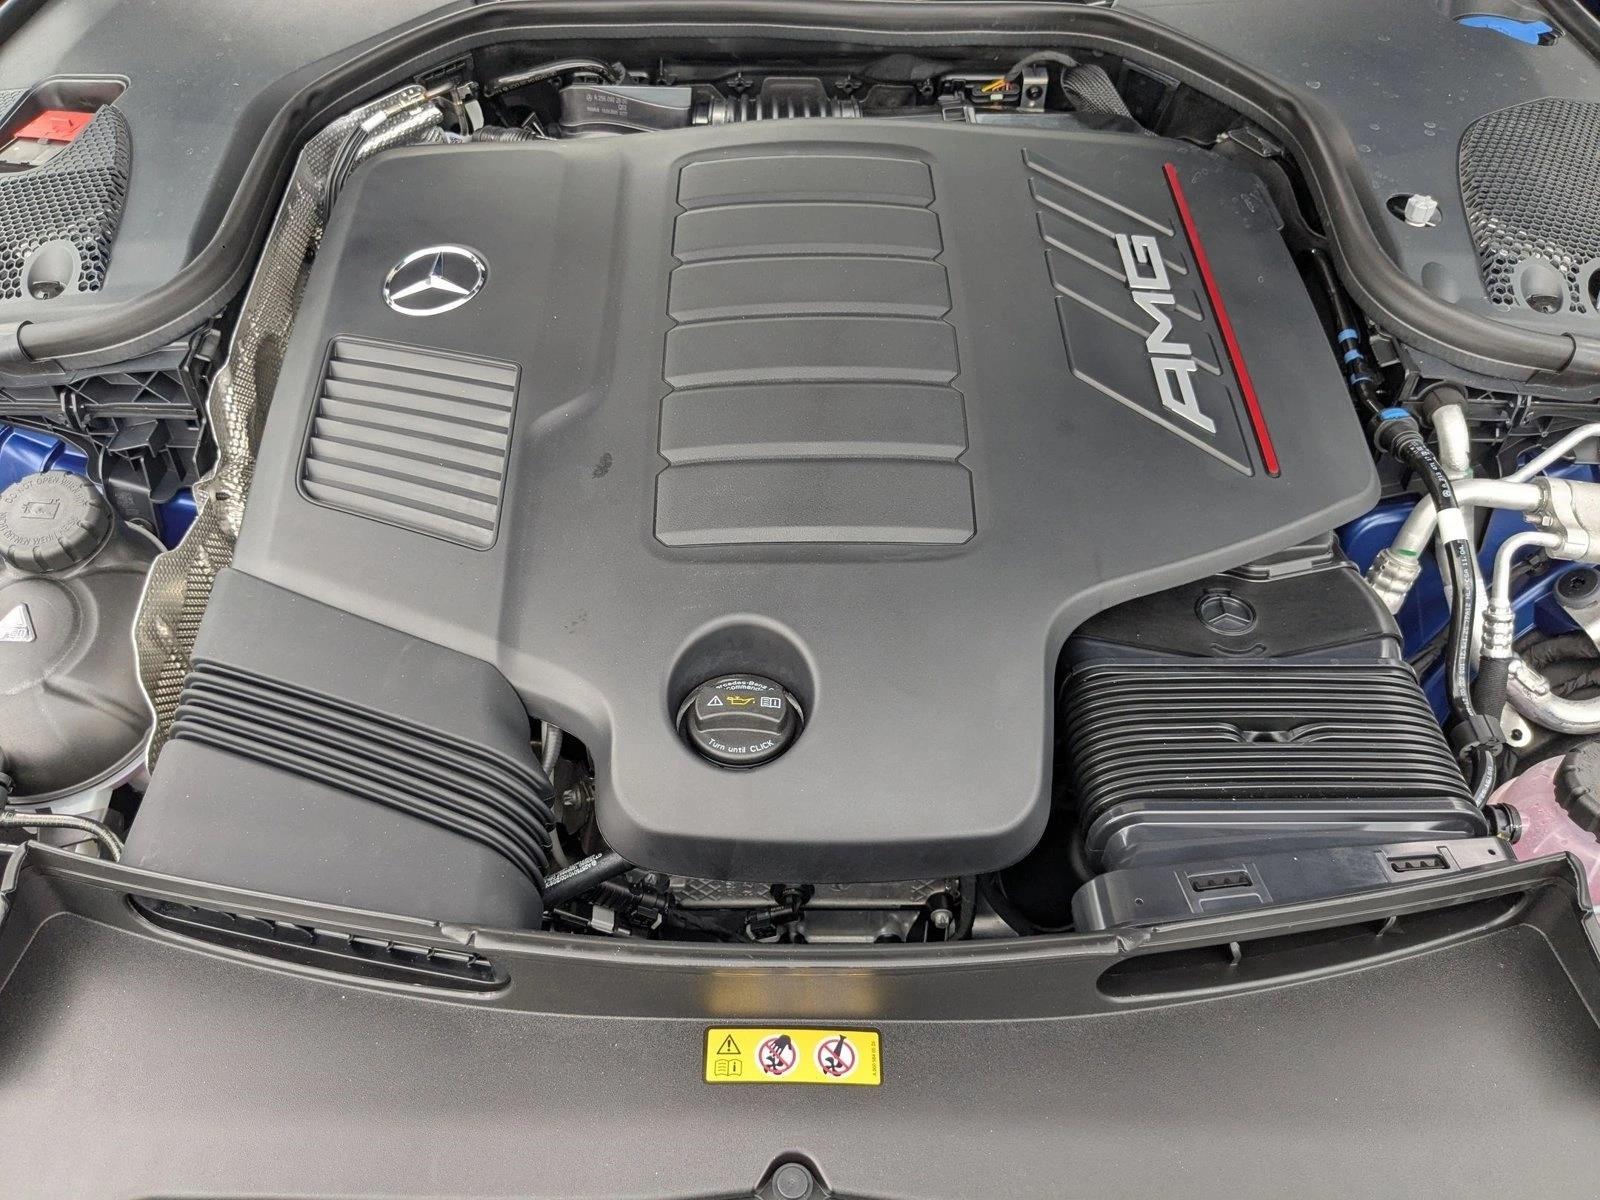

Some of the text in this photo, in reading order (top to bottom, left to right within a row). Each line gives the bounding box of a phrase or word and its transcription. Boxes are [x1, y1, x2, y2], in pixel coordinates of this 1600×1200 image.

[1115, 233, 1217, 434] AMG
[708, 738, 725, 751] Turn
[749, 740, 775, 753] CLICK
